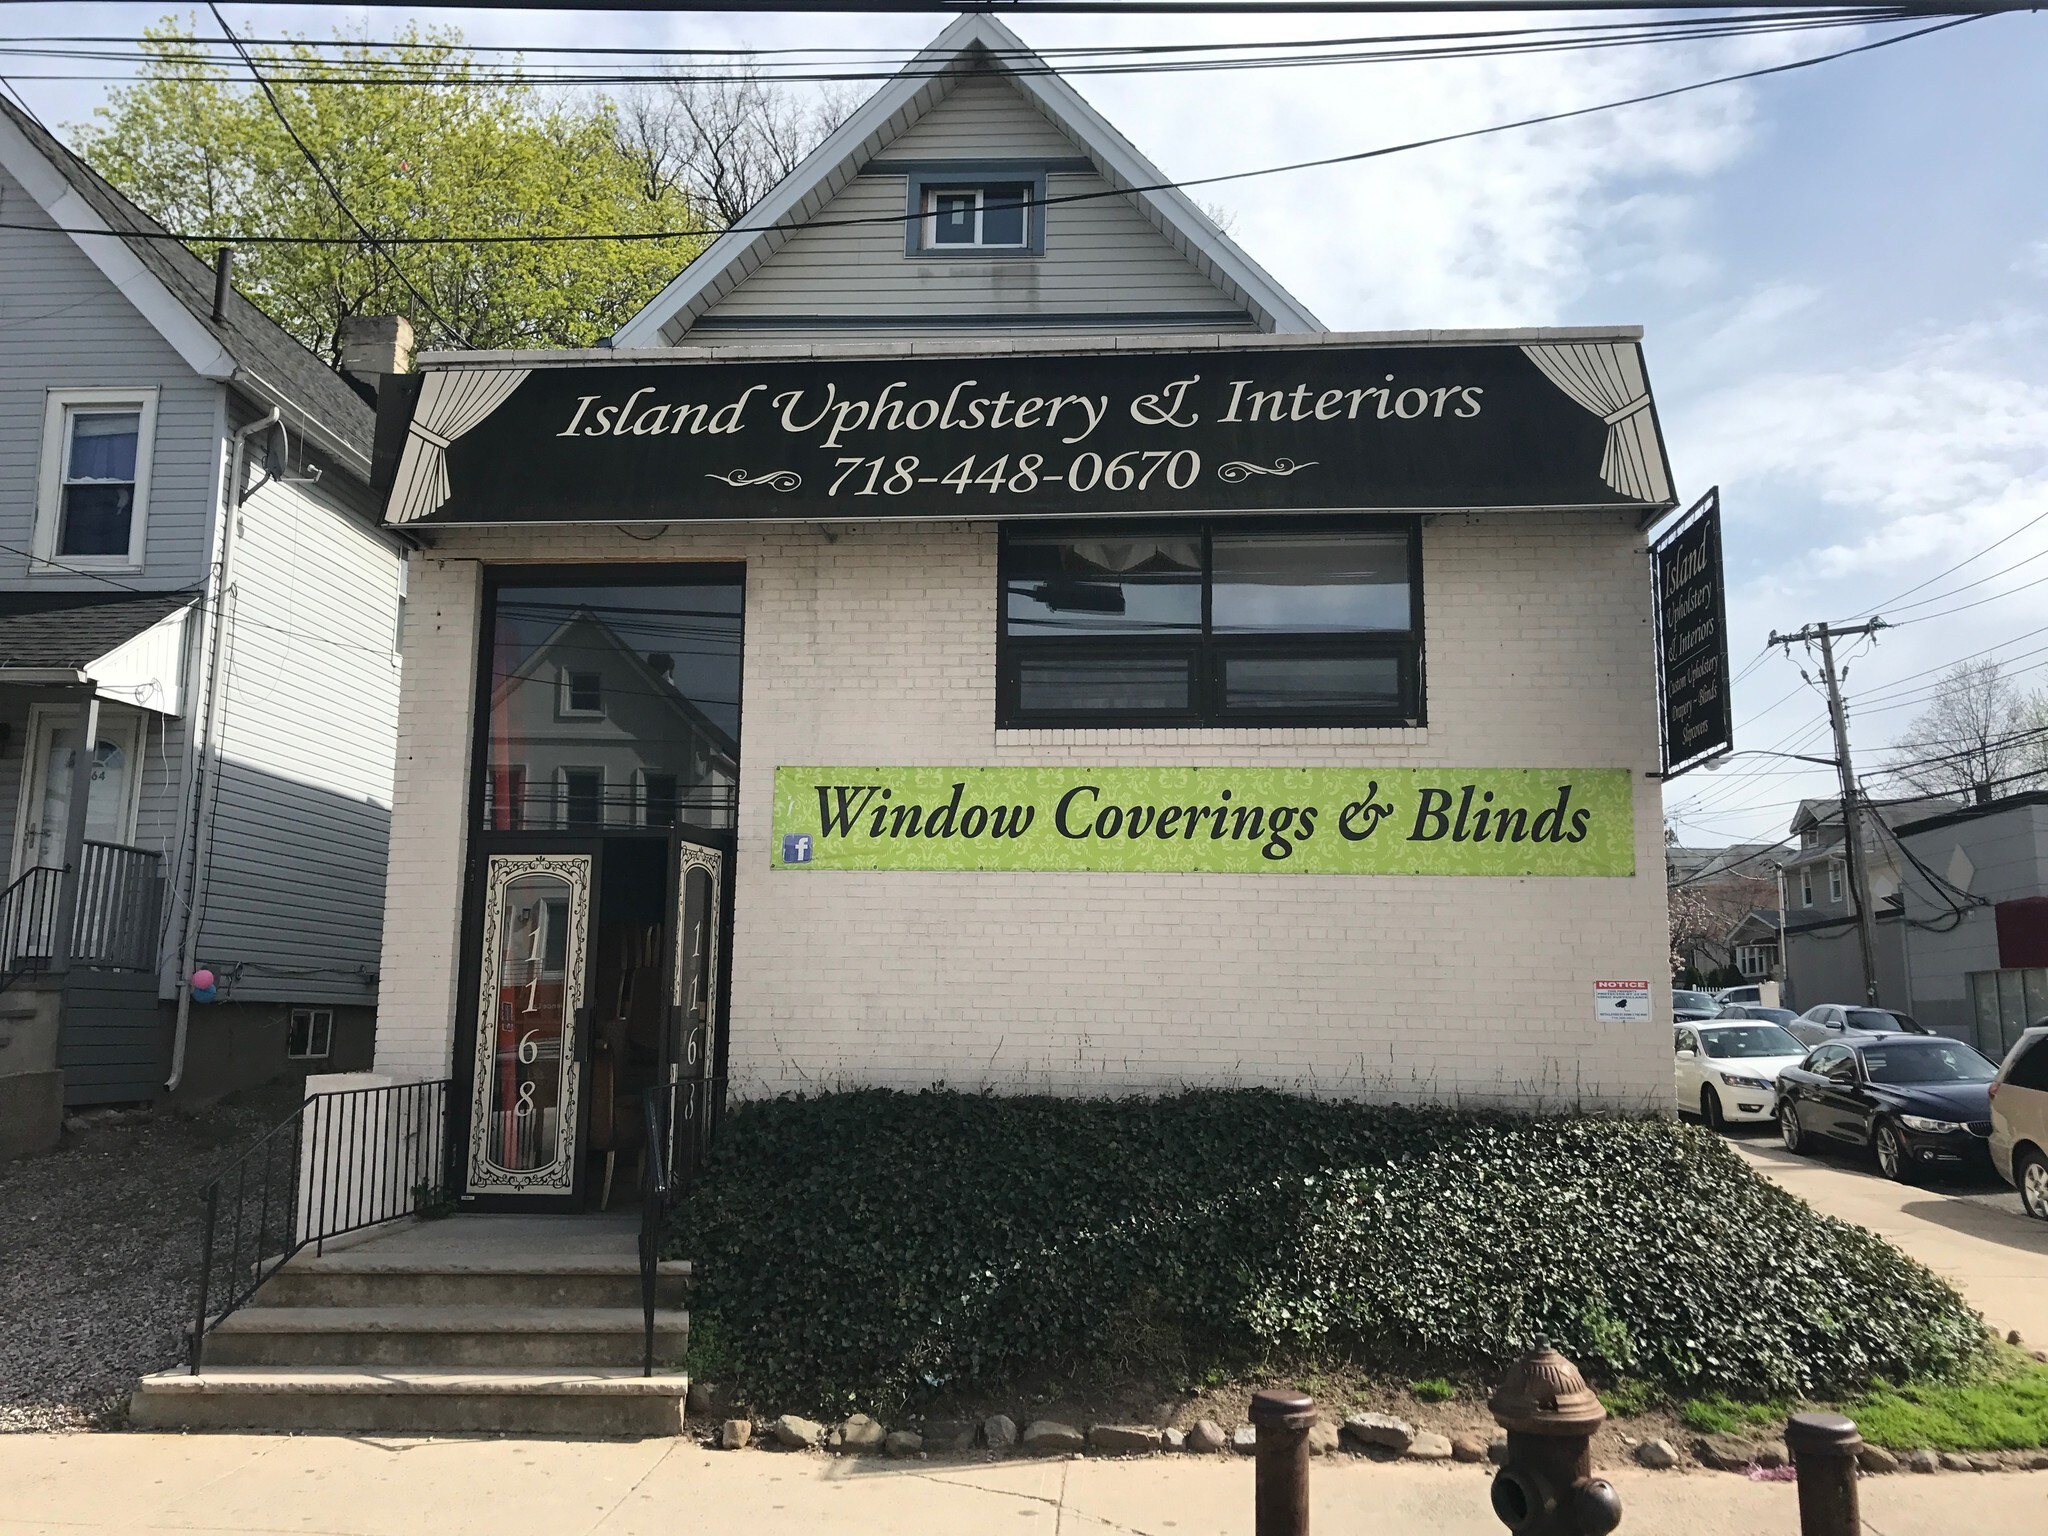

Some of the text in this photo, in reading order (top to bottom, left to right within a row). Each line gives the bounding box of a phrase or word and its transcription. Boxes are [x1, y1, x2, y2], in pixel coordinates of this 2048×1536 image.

[556, 375, 1483, 448] Island Upholstery & Interiors
[829, 450, 1200, 496] 718-448-0670
[1664, 520, 1710, 599] Island
[1666, 582, 1712, 631] Upholstery
[1668, 617, 1714, 662] & Interiors
[1687, 655, 1718, 688] Upholstery
[815, 781, 1590, 860] Window Coverings & Blinds
